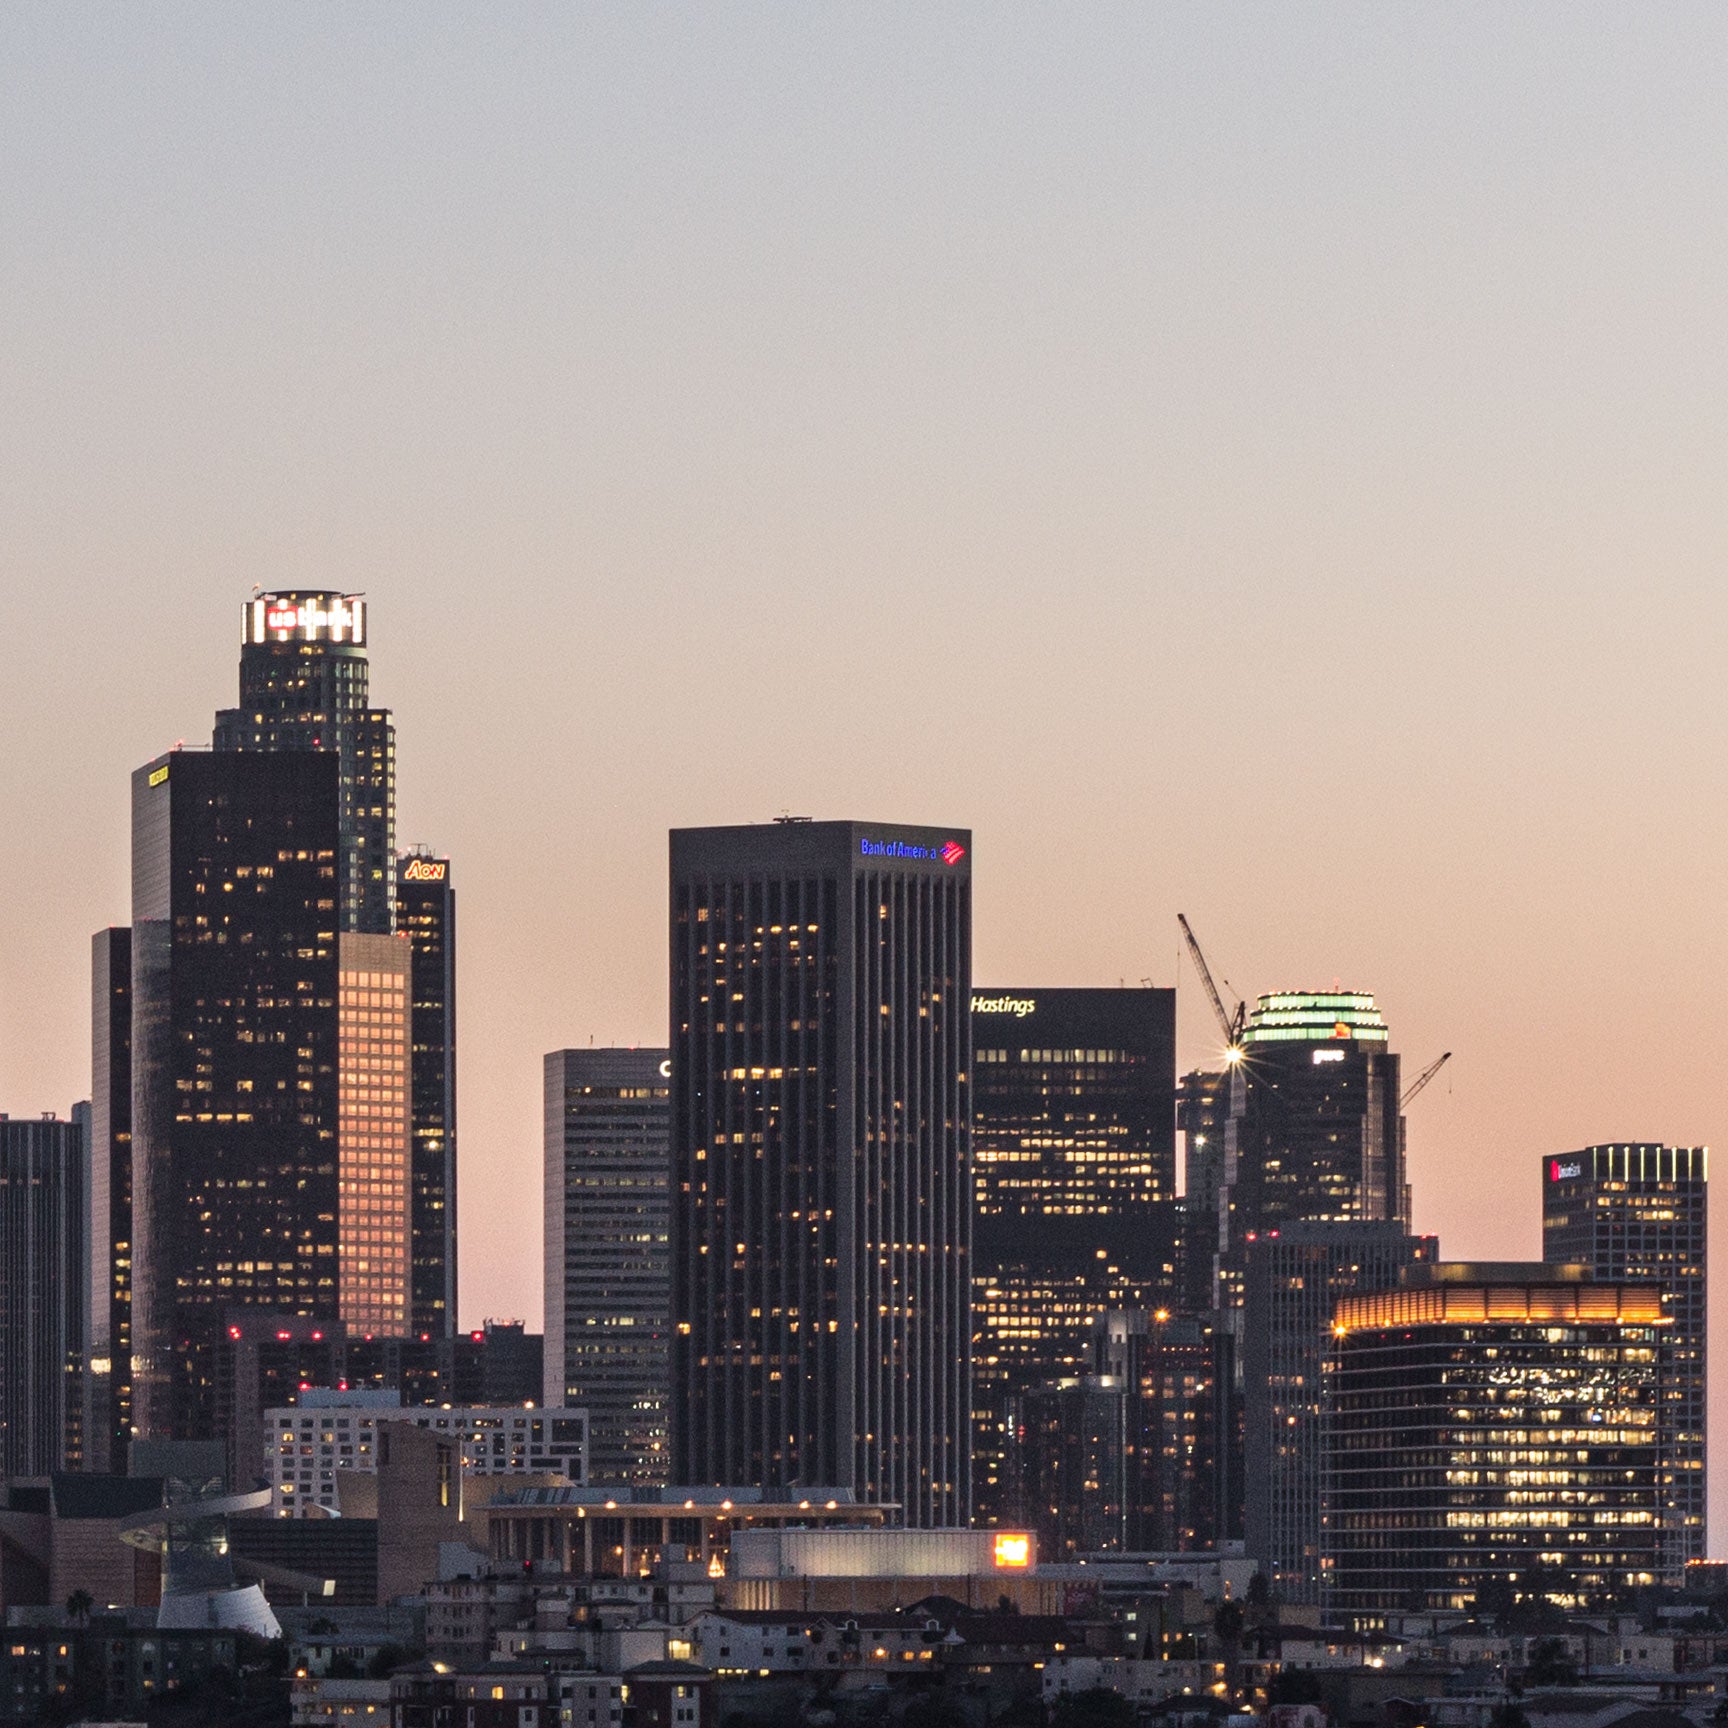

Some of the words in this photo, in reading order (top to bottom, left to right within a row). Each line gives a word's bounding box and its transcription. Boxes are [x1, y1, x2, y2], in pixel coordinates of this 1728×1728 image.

[861, 838, 885, 855] Bank
[886, 841, 896, 856] of
[897, 841, 936, 859] Ameria
[405, 860, 445, 880] AON
[971, 996, 1035, 1017] Hastings
